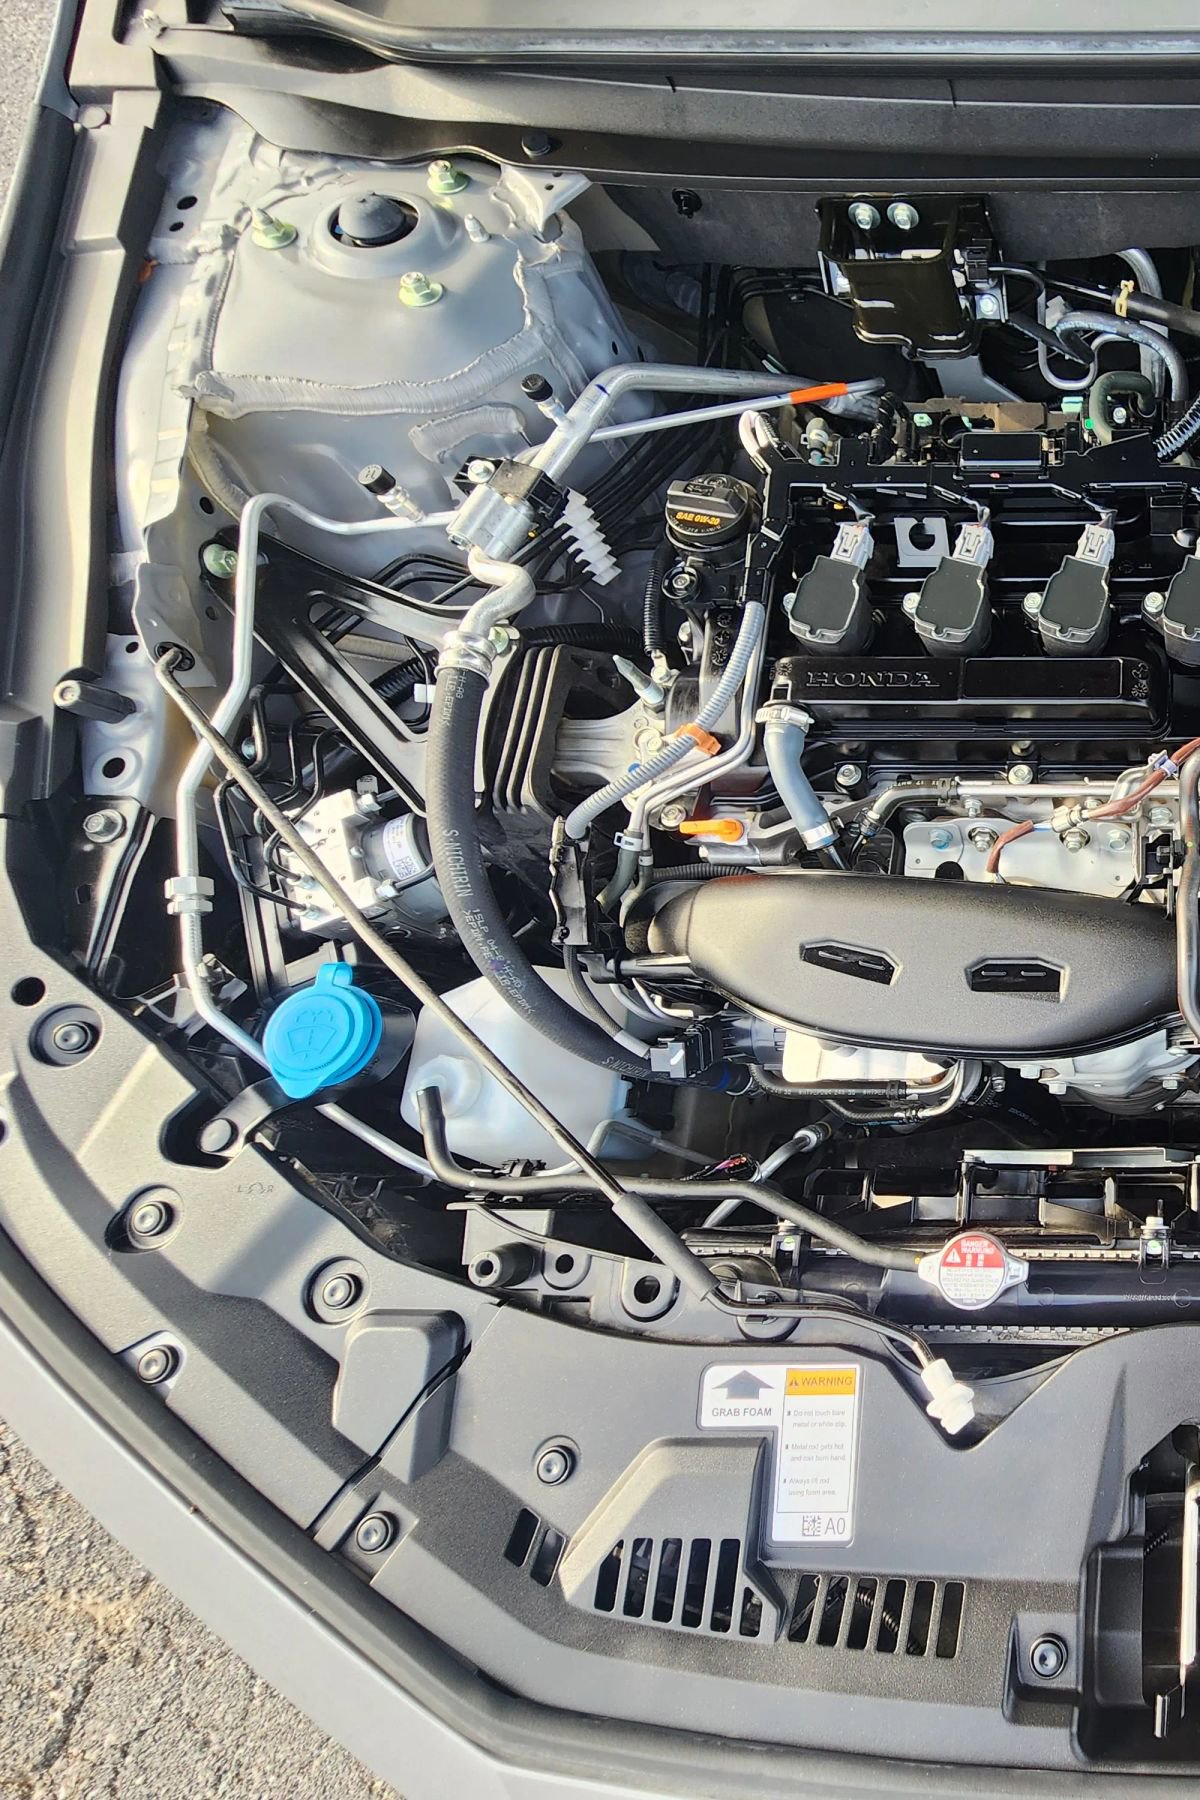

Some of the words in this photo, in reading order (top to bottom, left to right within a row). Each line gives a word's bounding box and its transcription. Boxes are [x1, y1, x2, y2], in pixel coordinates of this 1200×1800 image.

[675, 511, 695, 522] SAE
[806, 671, 941, 688] HONDA
[801, 1376, 853, 1387] WARNING
[711, 1408, 740, 1417] GRAB
[743, 1407, 772, 1417] FOAM
[824, 1517, 846, 1536] A0
